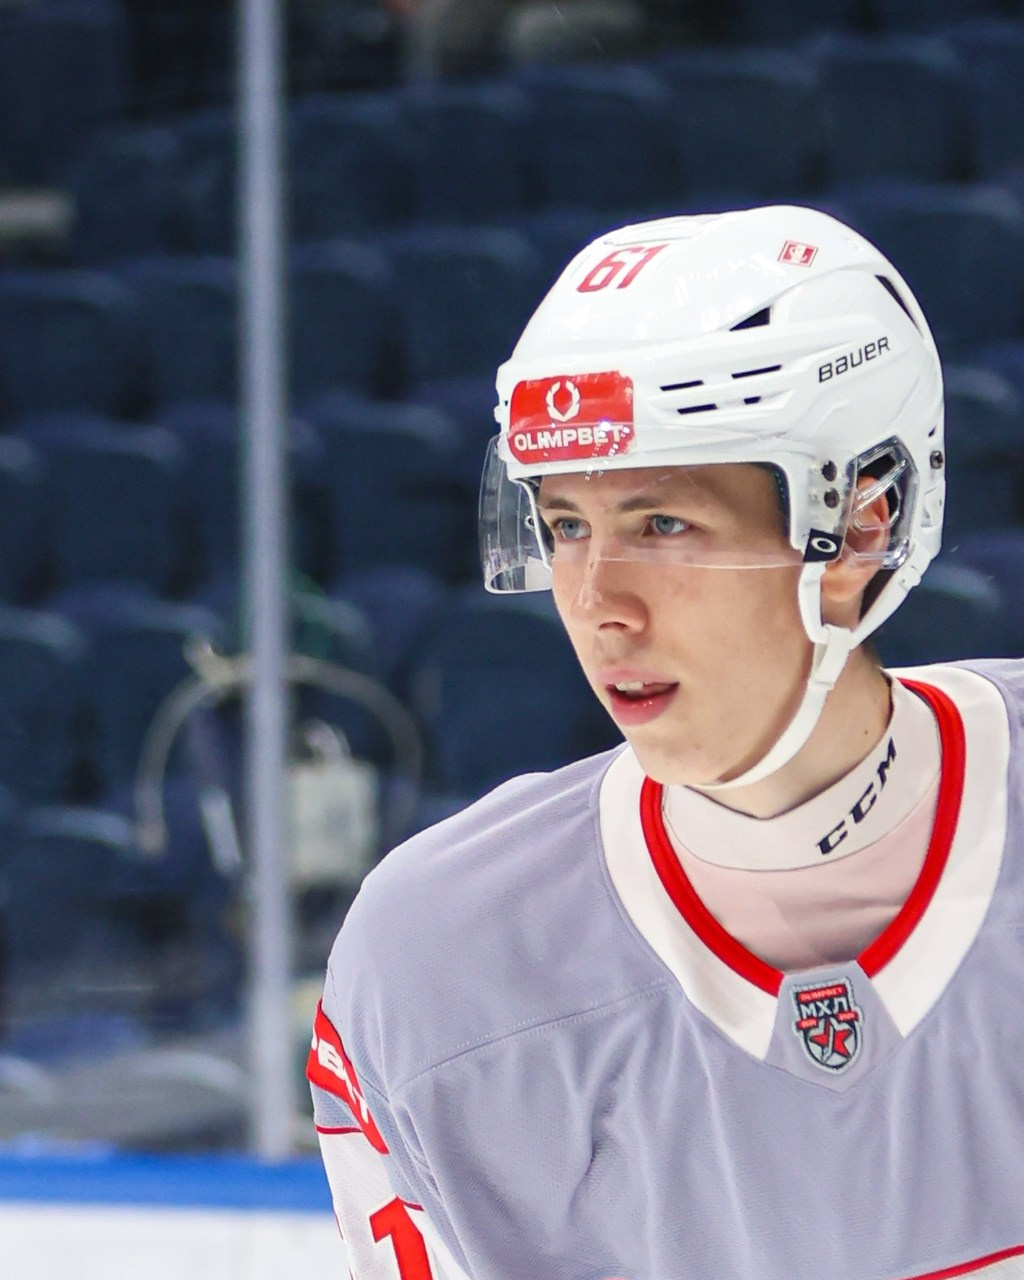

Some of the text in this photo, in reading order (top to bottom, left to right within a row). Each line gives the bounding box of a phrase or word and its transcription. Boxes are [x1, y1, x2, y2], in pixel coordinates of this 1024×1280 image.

[513, 424, 624, 452] OLIMPBET
[815, 737, 897, 855] CCM
[800, 997, 849, 1019] МХЛ
